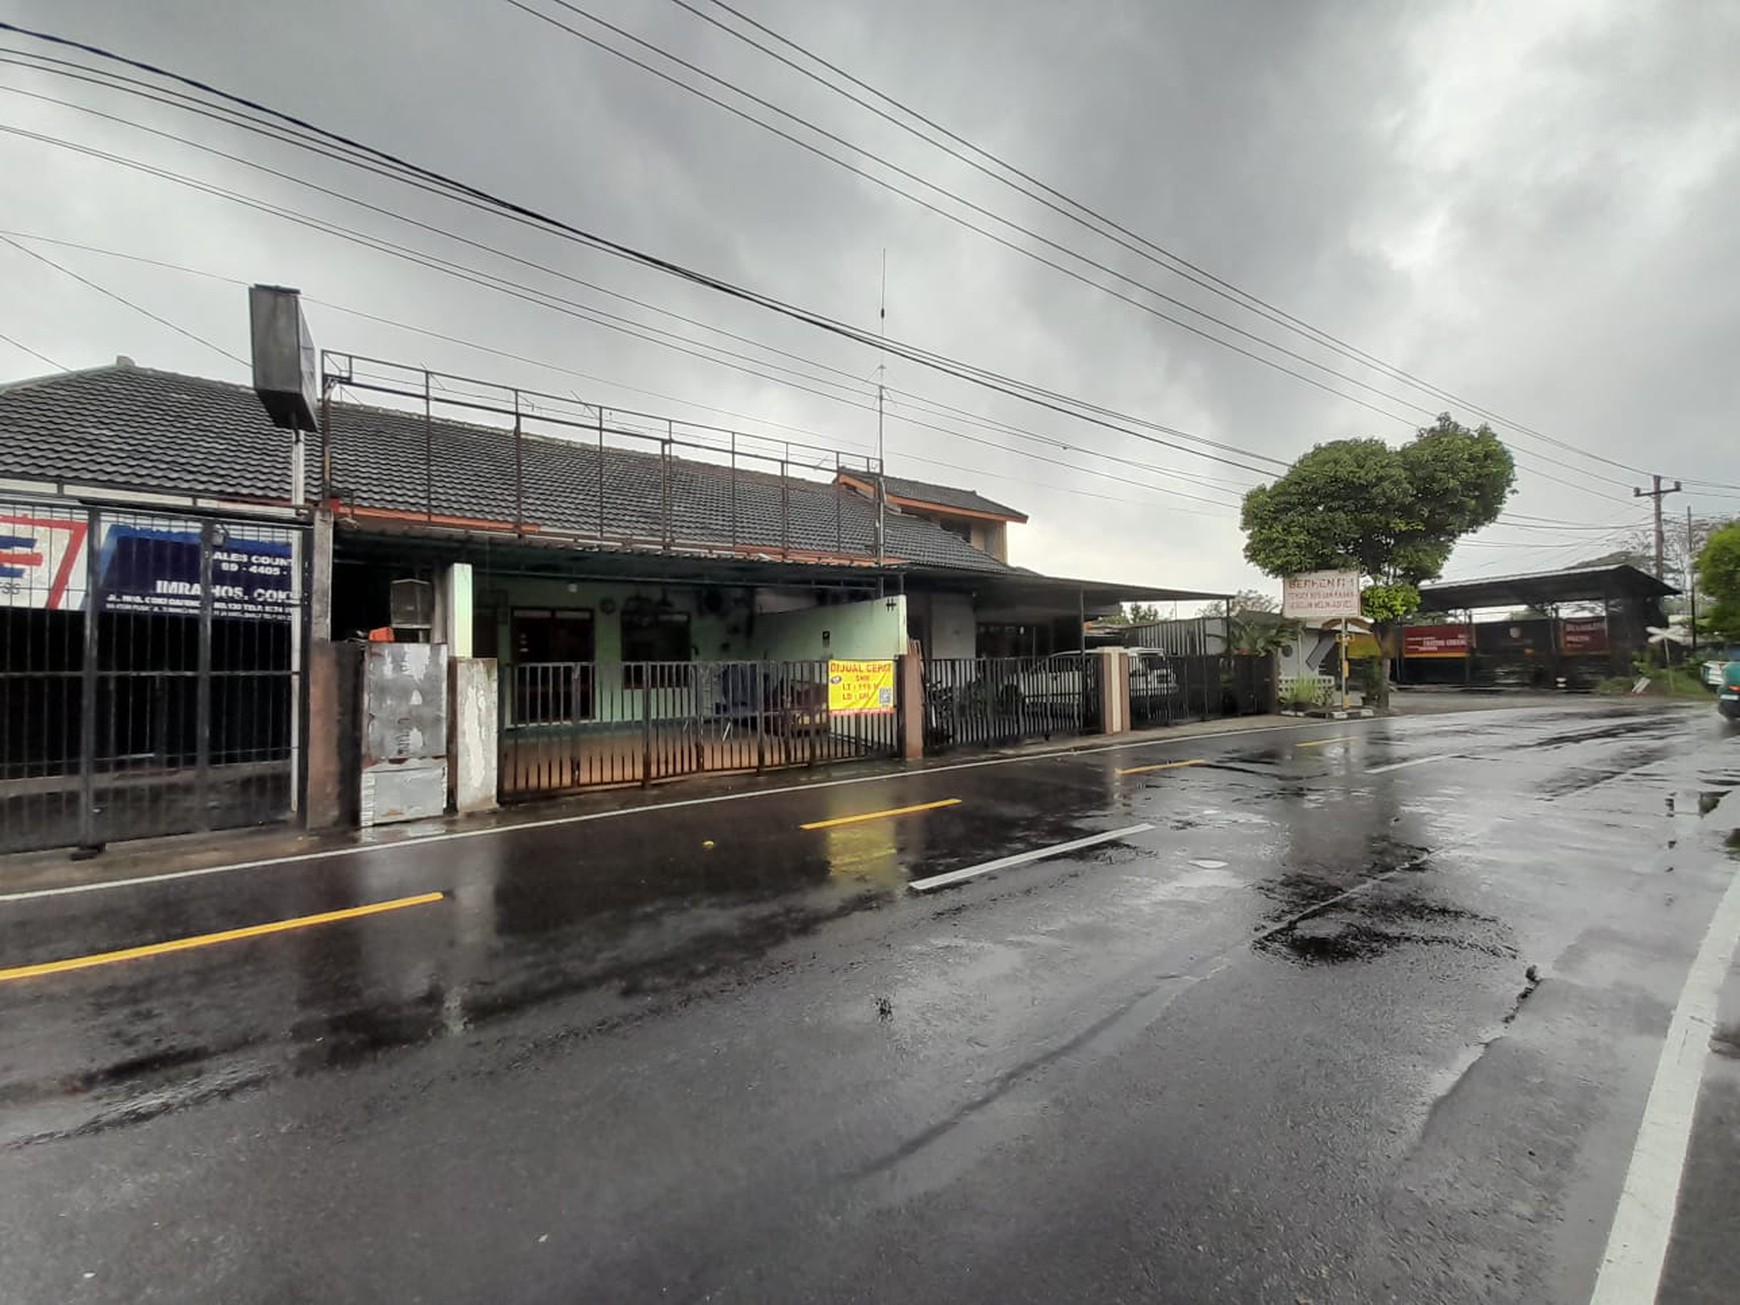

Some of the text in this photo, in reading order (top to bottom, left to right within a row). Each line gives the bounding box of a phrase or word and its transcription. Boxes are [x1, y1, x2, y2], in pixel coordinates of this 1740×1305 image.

[211, 551, 248, 562] ALES
[156, 580, 201, 595] IMRA
[830, 663, 863, 673] DIJUAL
